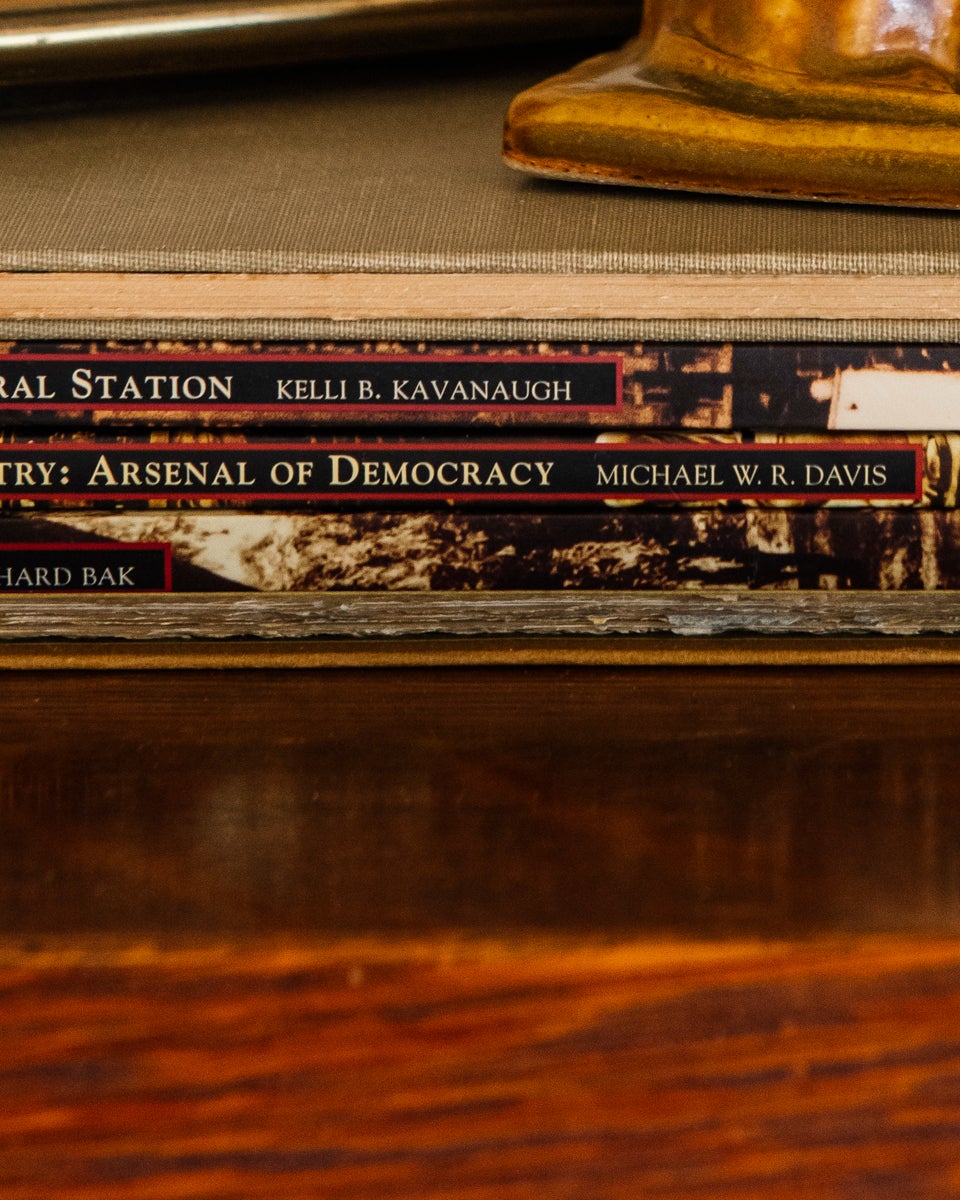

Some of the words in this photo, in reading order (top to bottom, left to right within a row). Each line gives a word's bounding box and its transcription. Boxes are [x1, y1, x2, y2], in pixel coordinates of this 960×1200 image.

[71, 368, 234, 400] STATION
[276, 379, 348, 400] KELLI
[358, 379, 382, 400] B.
[392, 379, 573, 401] KAVANAUGH
[0, 461, 70, 486] TRY:
[87, 454, 257, 486] ARSENAL
[270, 461, 315, 486] OF
[328, 454, 555, 486] DEMOCRACY
[596, 464, 724, 487] MICHAEL
[732, 464, 764, 487] W.
[771, 464, 796, 487] R.
[804, 464, 888, 487] DAVIS
[83, 566, 136, 587] BAK
